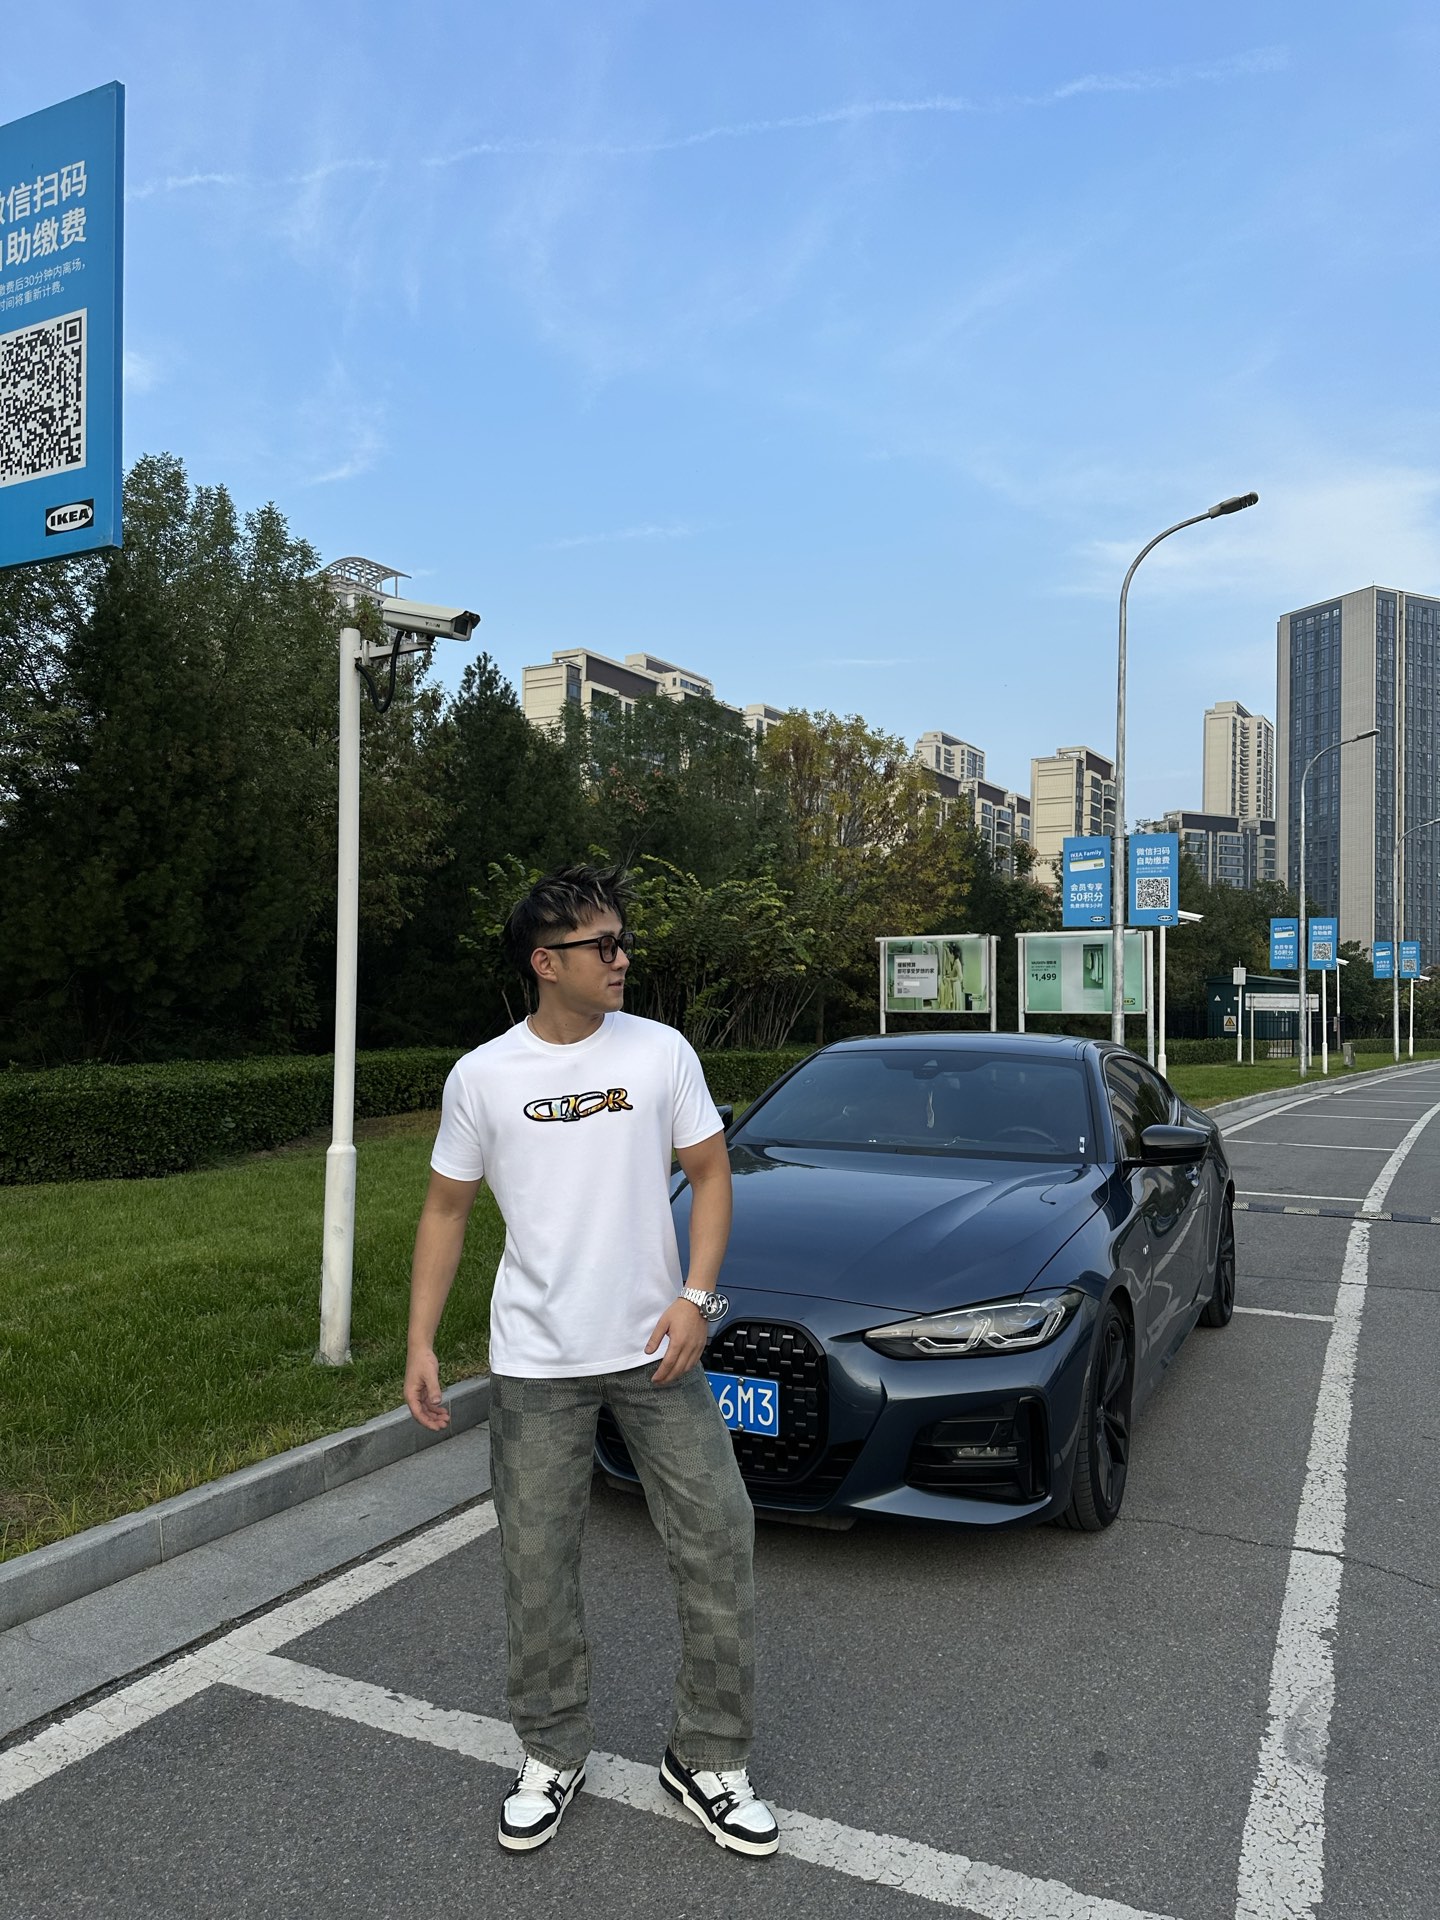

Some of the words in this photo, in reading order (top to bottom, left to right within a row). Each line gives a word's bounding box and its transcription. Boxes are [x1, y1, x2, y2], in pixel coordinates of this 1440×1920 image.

[0, 160, 87, 225] 信扫码
[0, 207, 87, 272] 助缴费
[50, 507, 90, 527] IKEA
[1136, 847, 1170, 856] 微信扫码
[1070, 892, 1104, 902] 50积分
[708, 1381, 774, 1426] 6M3
